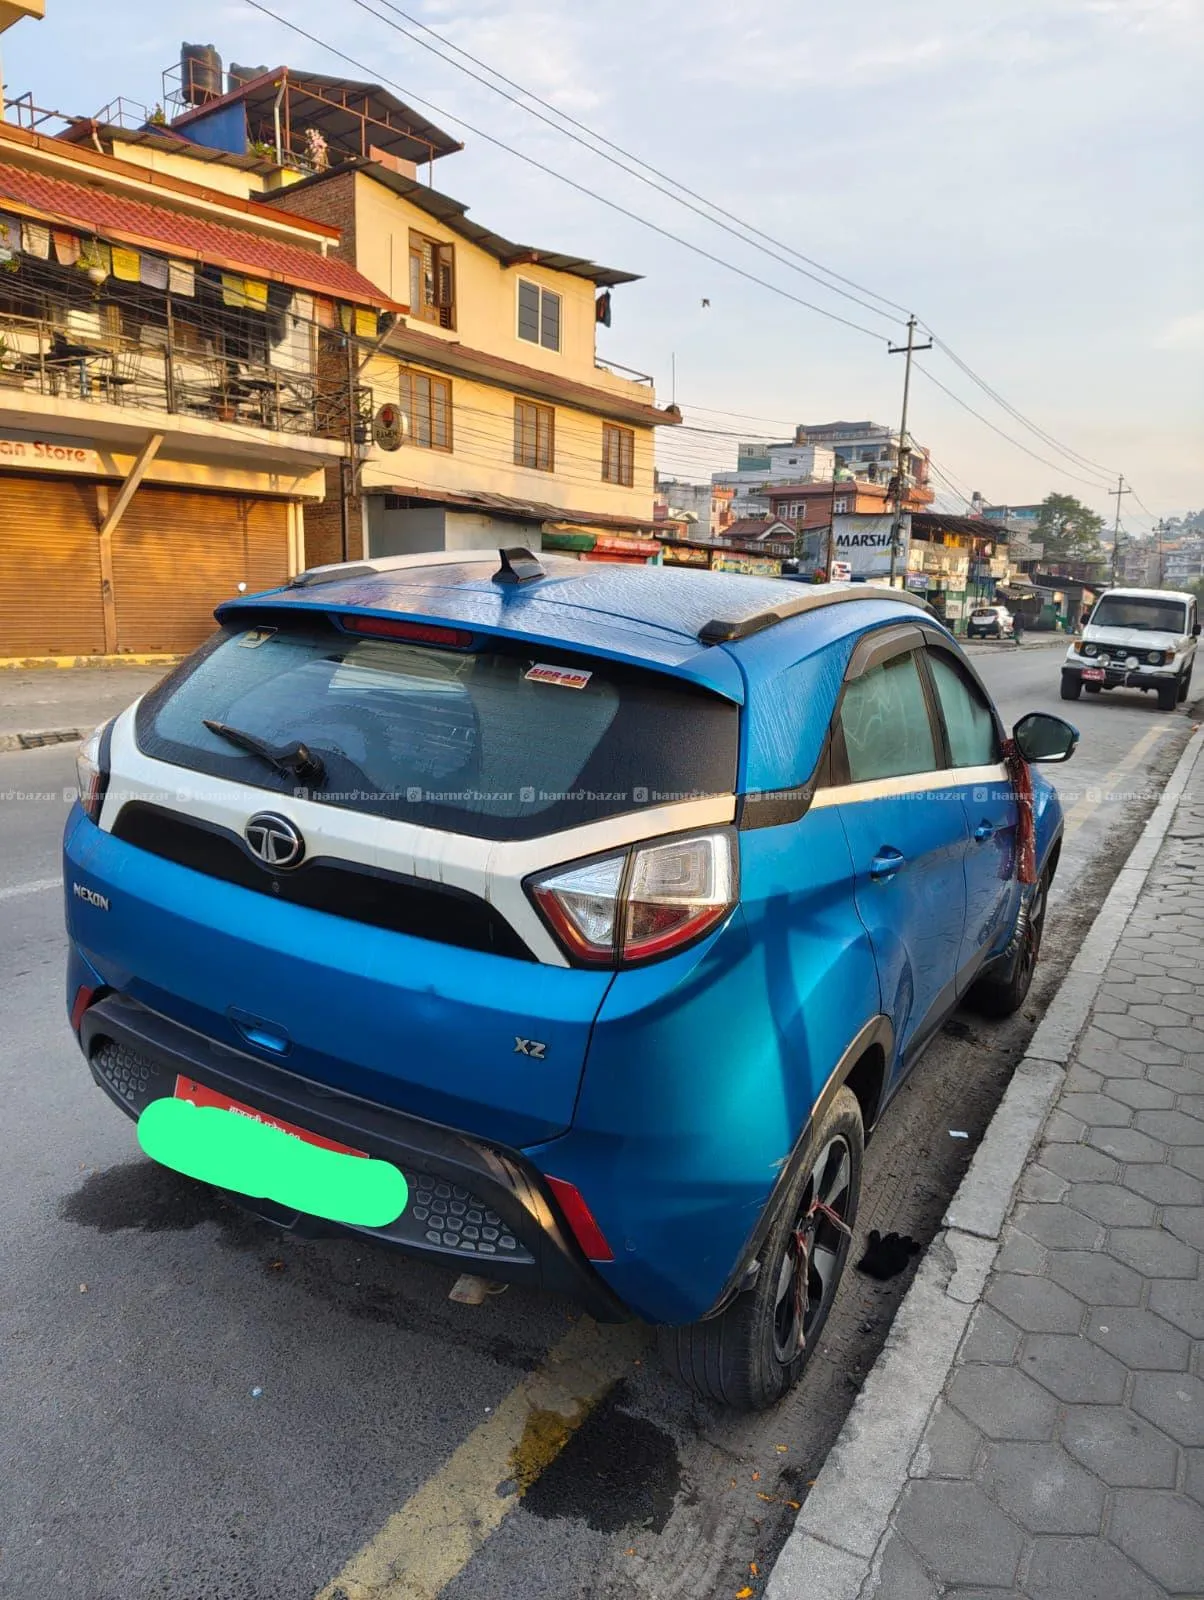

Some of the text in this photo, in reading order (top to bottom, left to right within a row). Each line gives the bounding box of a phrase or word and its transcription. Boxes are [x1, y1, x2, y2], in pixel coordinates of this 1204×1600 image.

[33, 440, 87, 462] Store
[73, 882, 109, 912] NEXON
[514, 1036, 546, 1059] XZ
